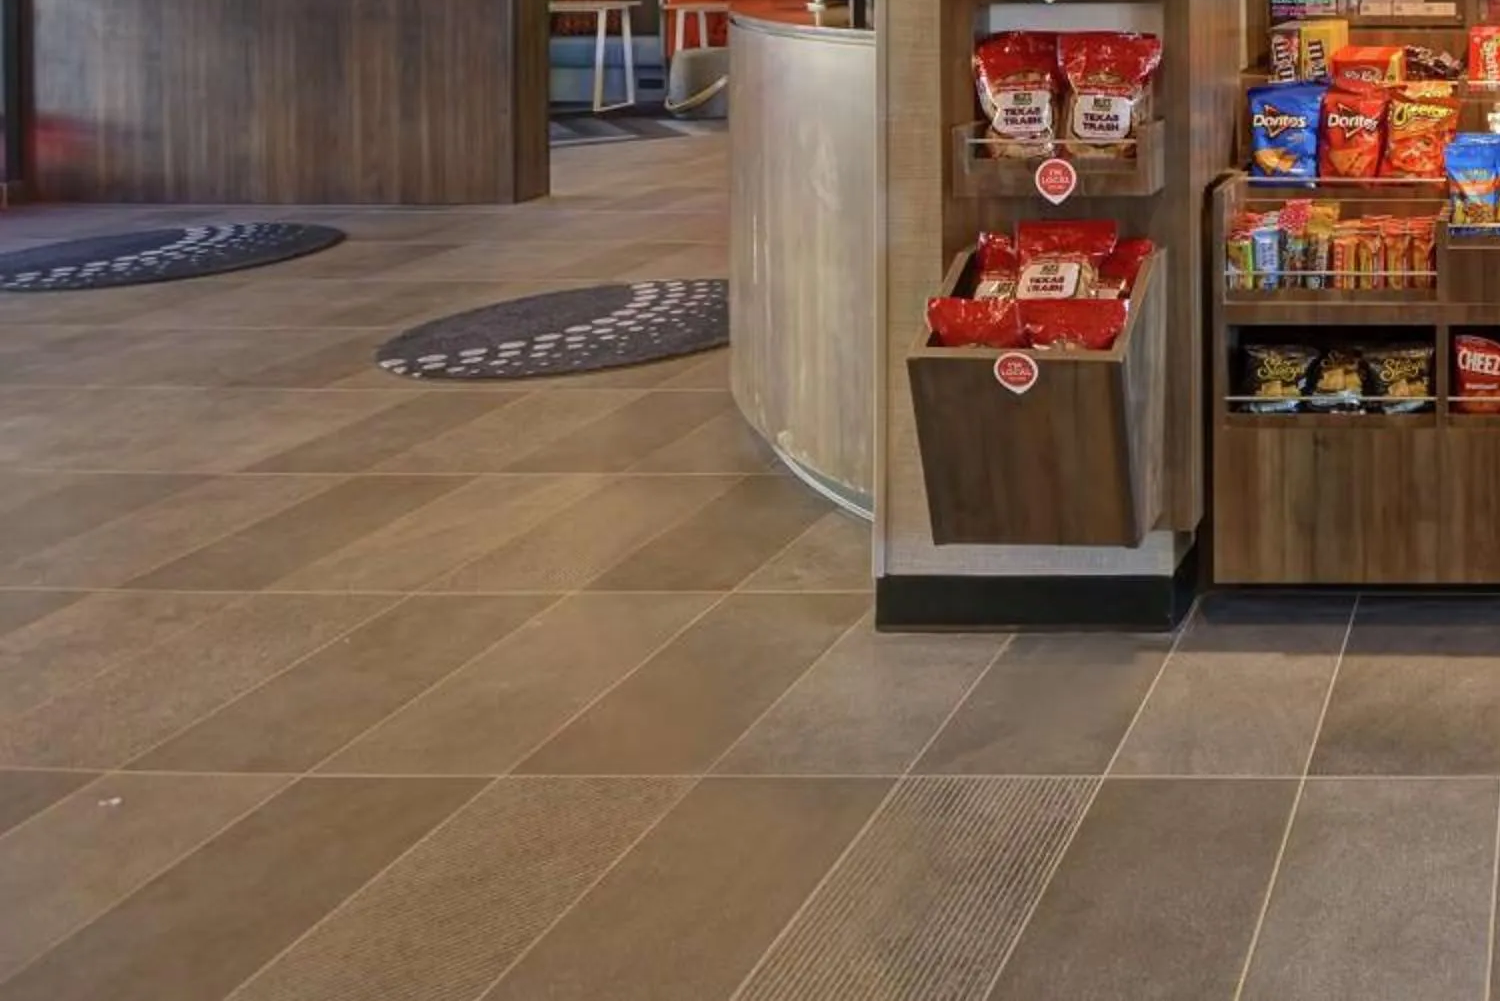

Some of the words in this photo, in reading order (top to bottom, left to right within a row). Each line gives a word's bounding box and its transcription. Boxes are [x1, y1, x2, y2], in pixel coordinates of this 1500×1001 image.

[1004, 107, 1040, 115] TEXAS
[1004, 116, 1042, 125] TRASH
[1083, 113, 1119, 121] TEXAS
[1253, 114, 1307, 129] Doritos
[1083, 122, 1119, 131] TRASH
[1327, 114, 1379, 130] Doritos
